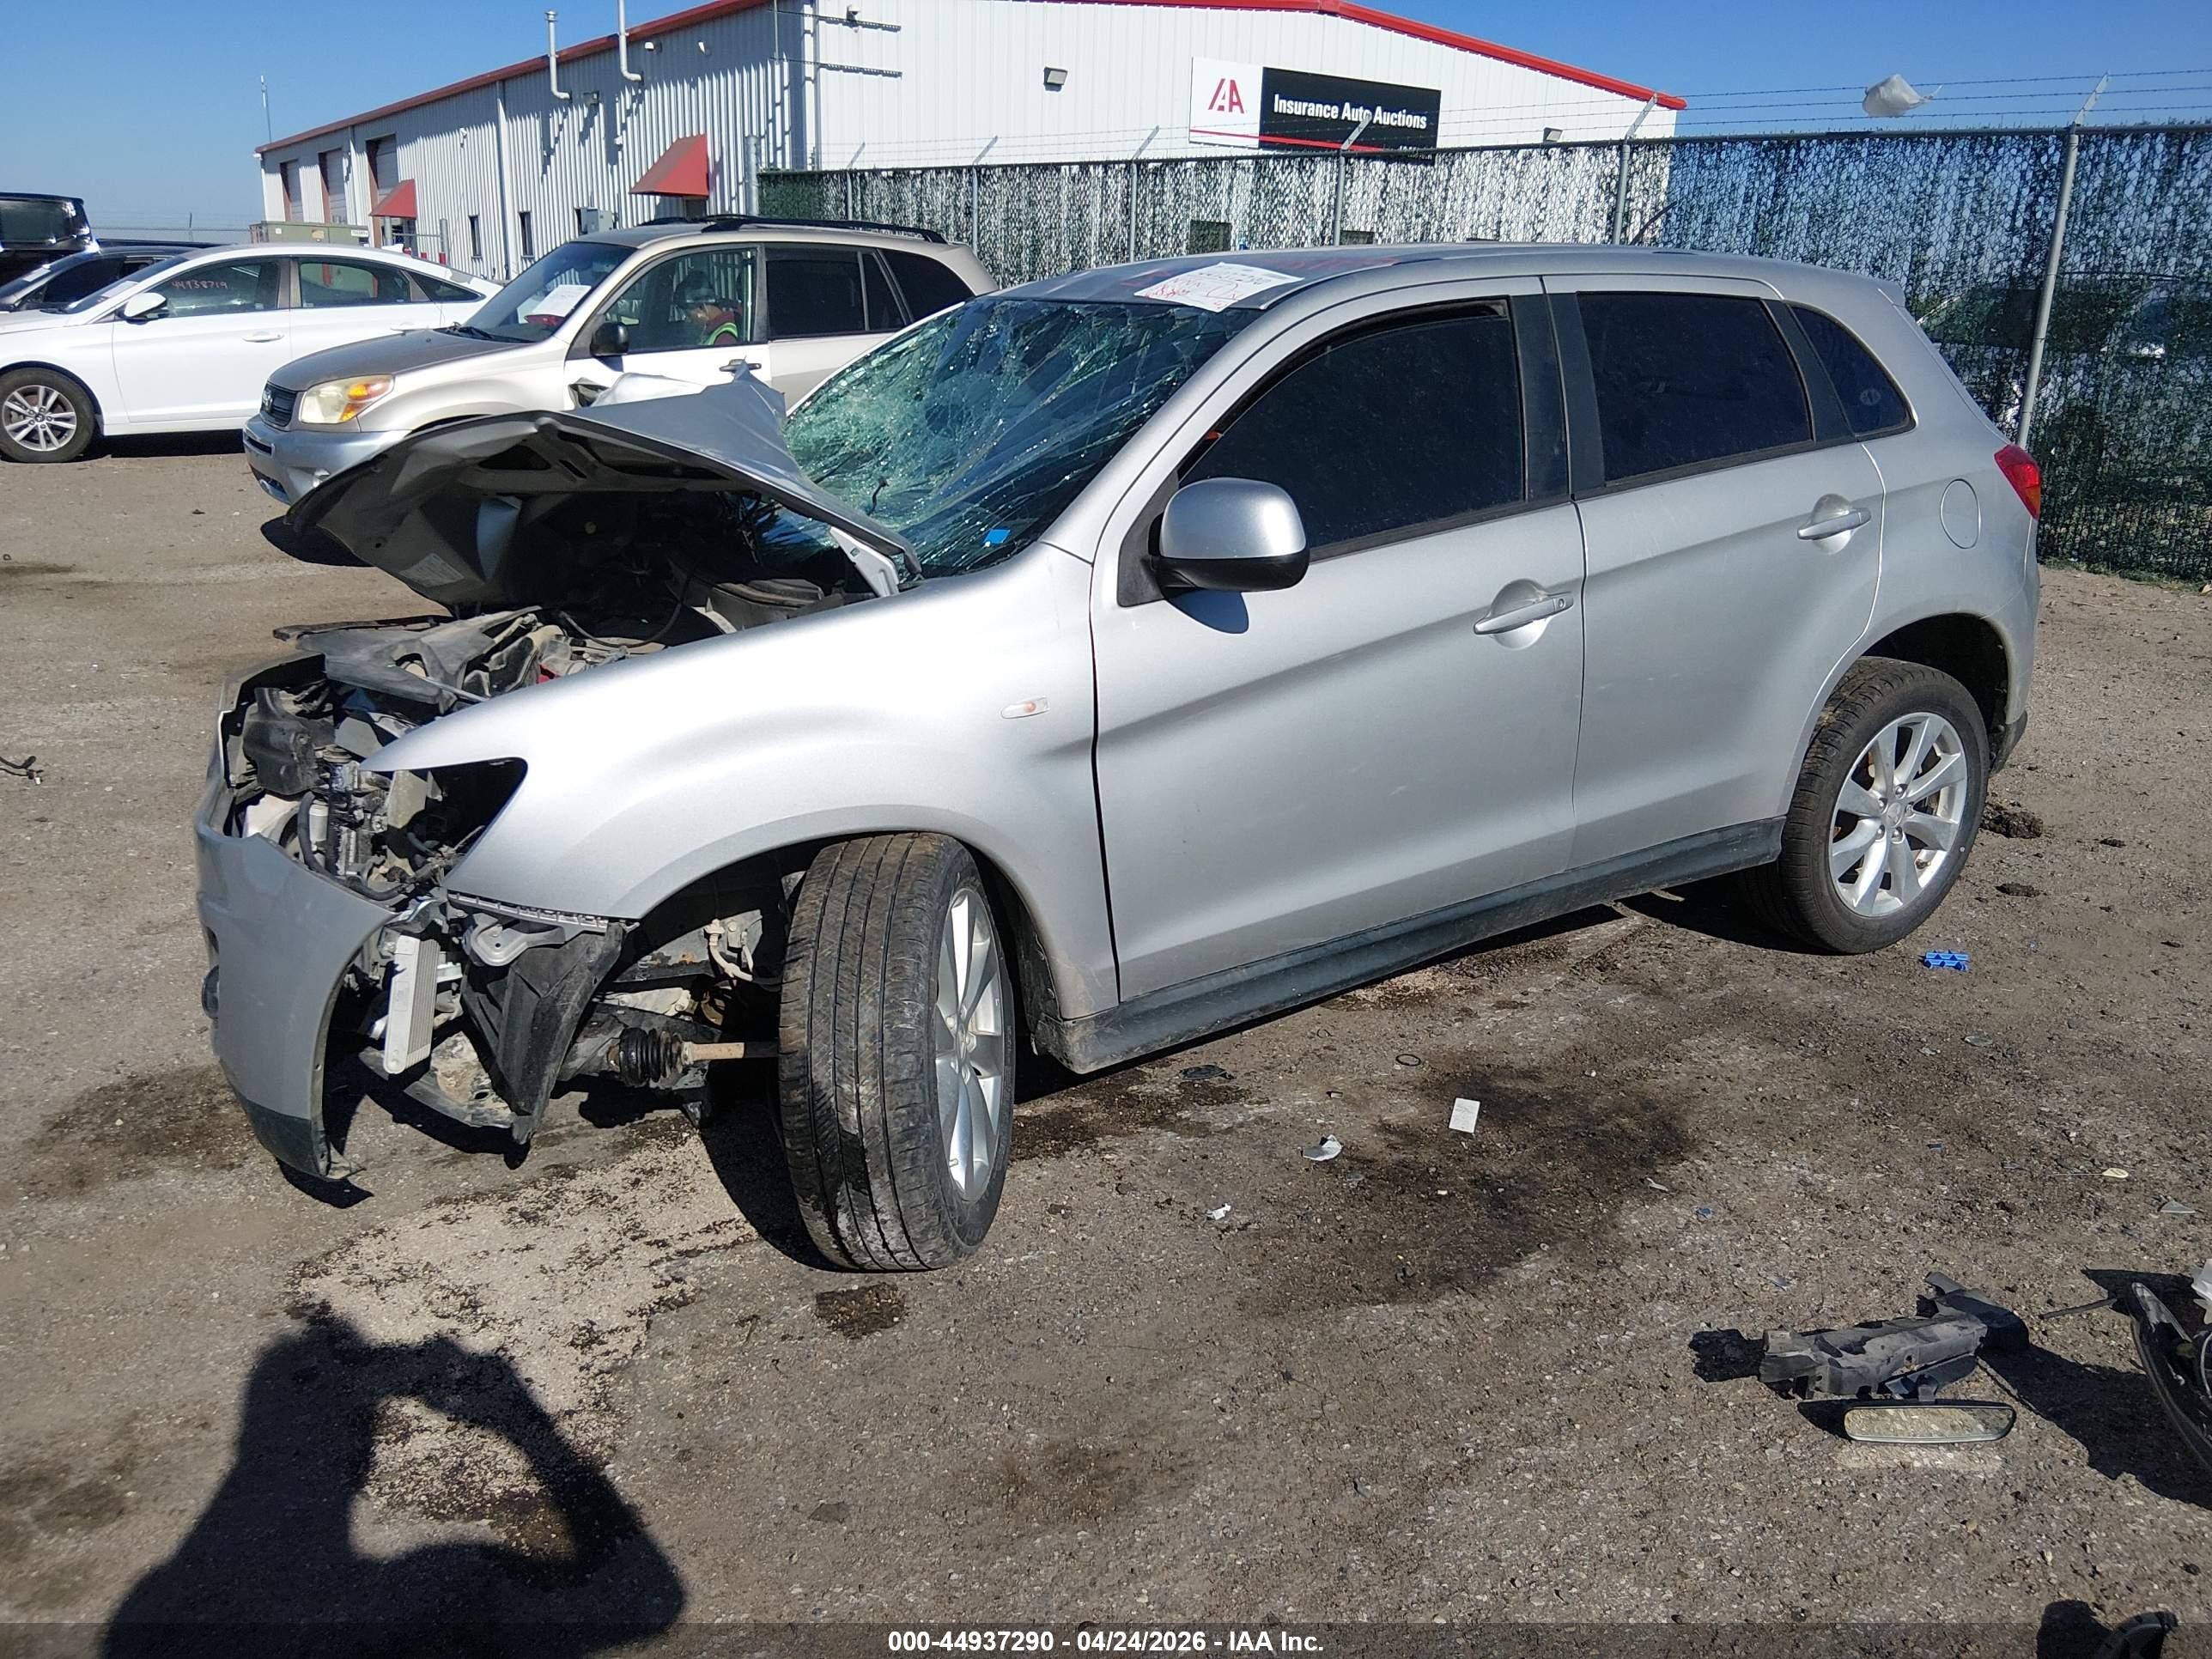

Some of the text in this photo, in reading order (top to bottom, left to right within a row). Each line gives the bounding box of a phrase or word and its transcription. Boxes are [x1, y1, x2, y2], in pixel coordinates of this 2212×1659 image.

[1273, 94, 1428, 130] Insurance Auto Auctions
